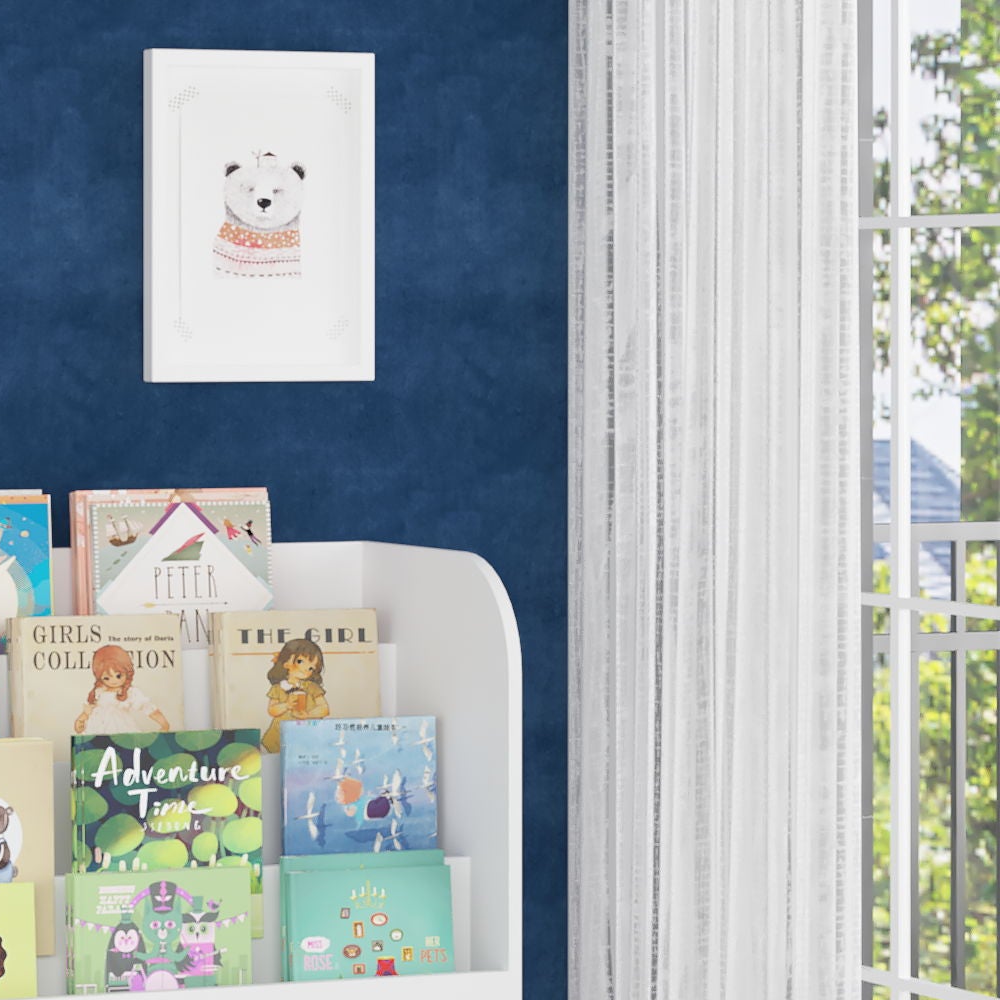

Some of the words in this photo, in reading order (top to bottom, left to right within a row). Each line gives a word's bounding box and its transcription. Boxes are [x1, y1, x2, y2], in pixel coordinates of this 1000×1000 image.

[153, 565, 218, 599] PETER
[33, 624, 102, 644] GIRLS
[237, 629, 291, 644] THE
[304, 628, 373, 643] GIRL
[33, 650, 176, 670] COLLION
[91, 746, 250, 788] Adventure
[127, 788, 214, 818] Time
[420, 948, 448, 963] PETS
